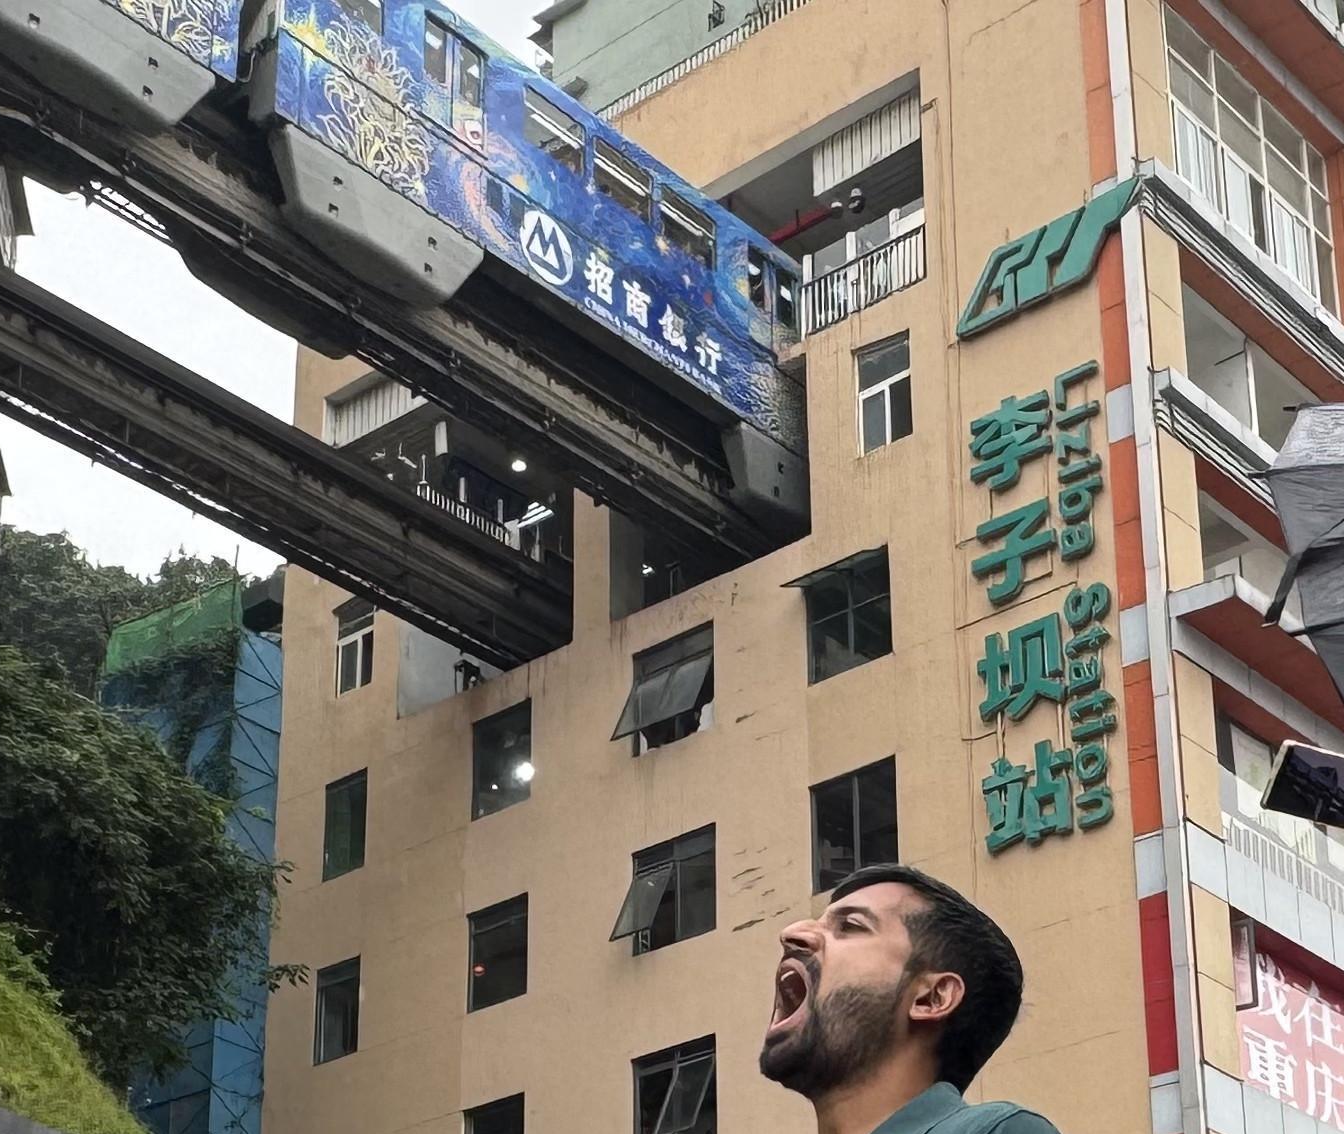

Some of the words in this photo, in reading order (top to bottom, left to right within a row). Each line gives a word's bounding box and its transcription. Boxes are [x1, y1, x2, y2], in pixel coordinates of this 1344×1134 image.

[583, 251, 722, 376] 招商银行
[1054, 359, 1104, 562] Liziba
[969, 389, 1074, 856] 李子坝站
[1063, 580, 1117, 832] Station
